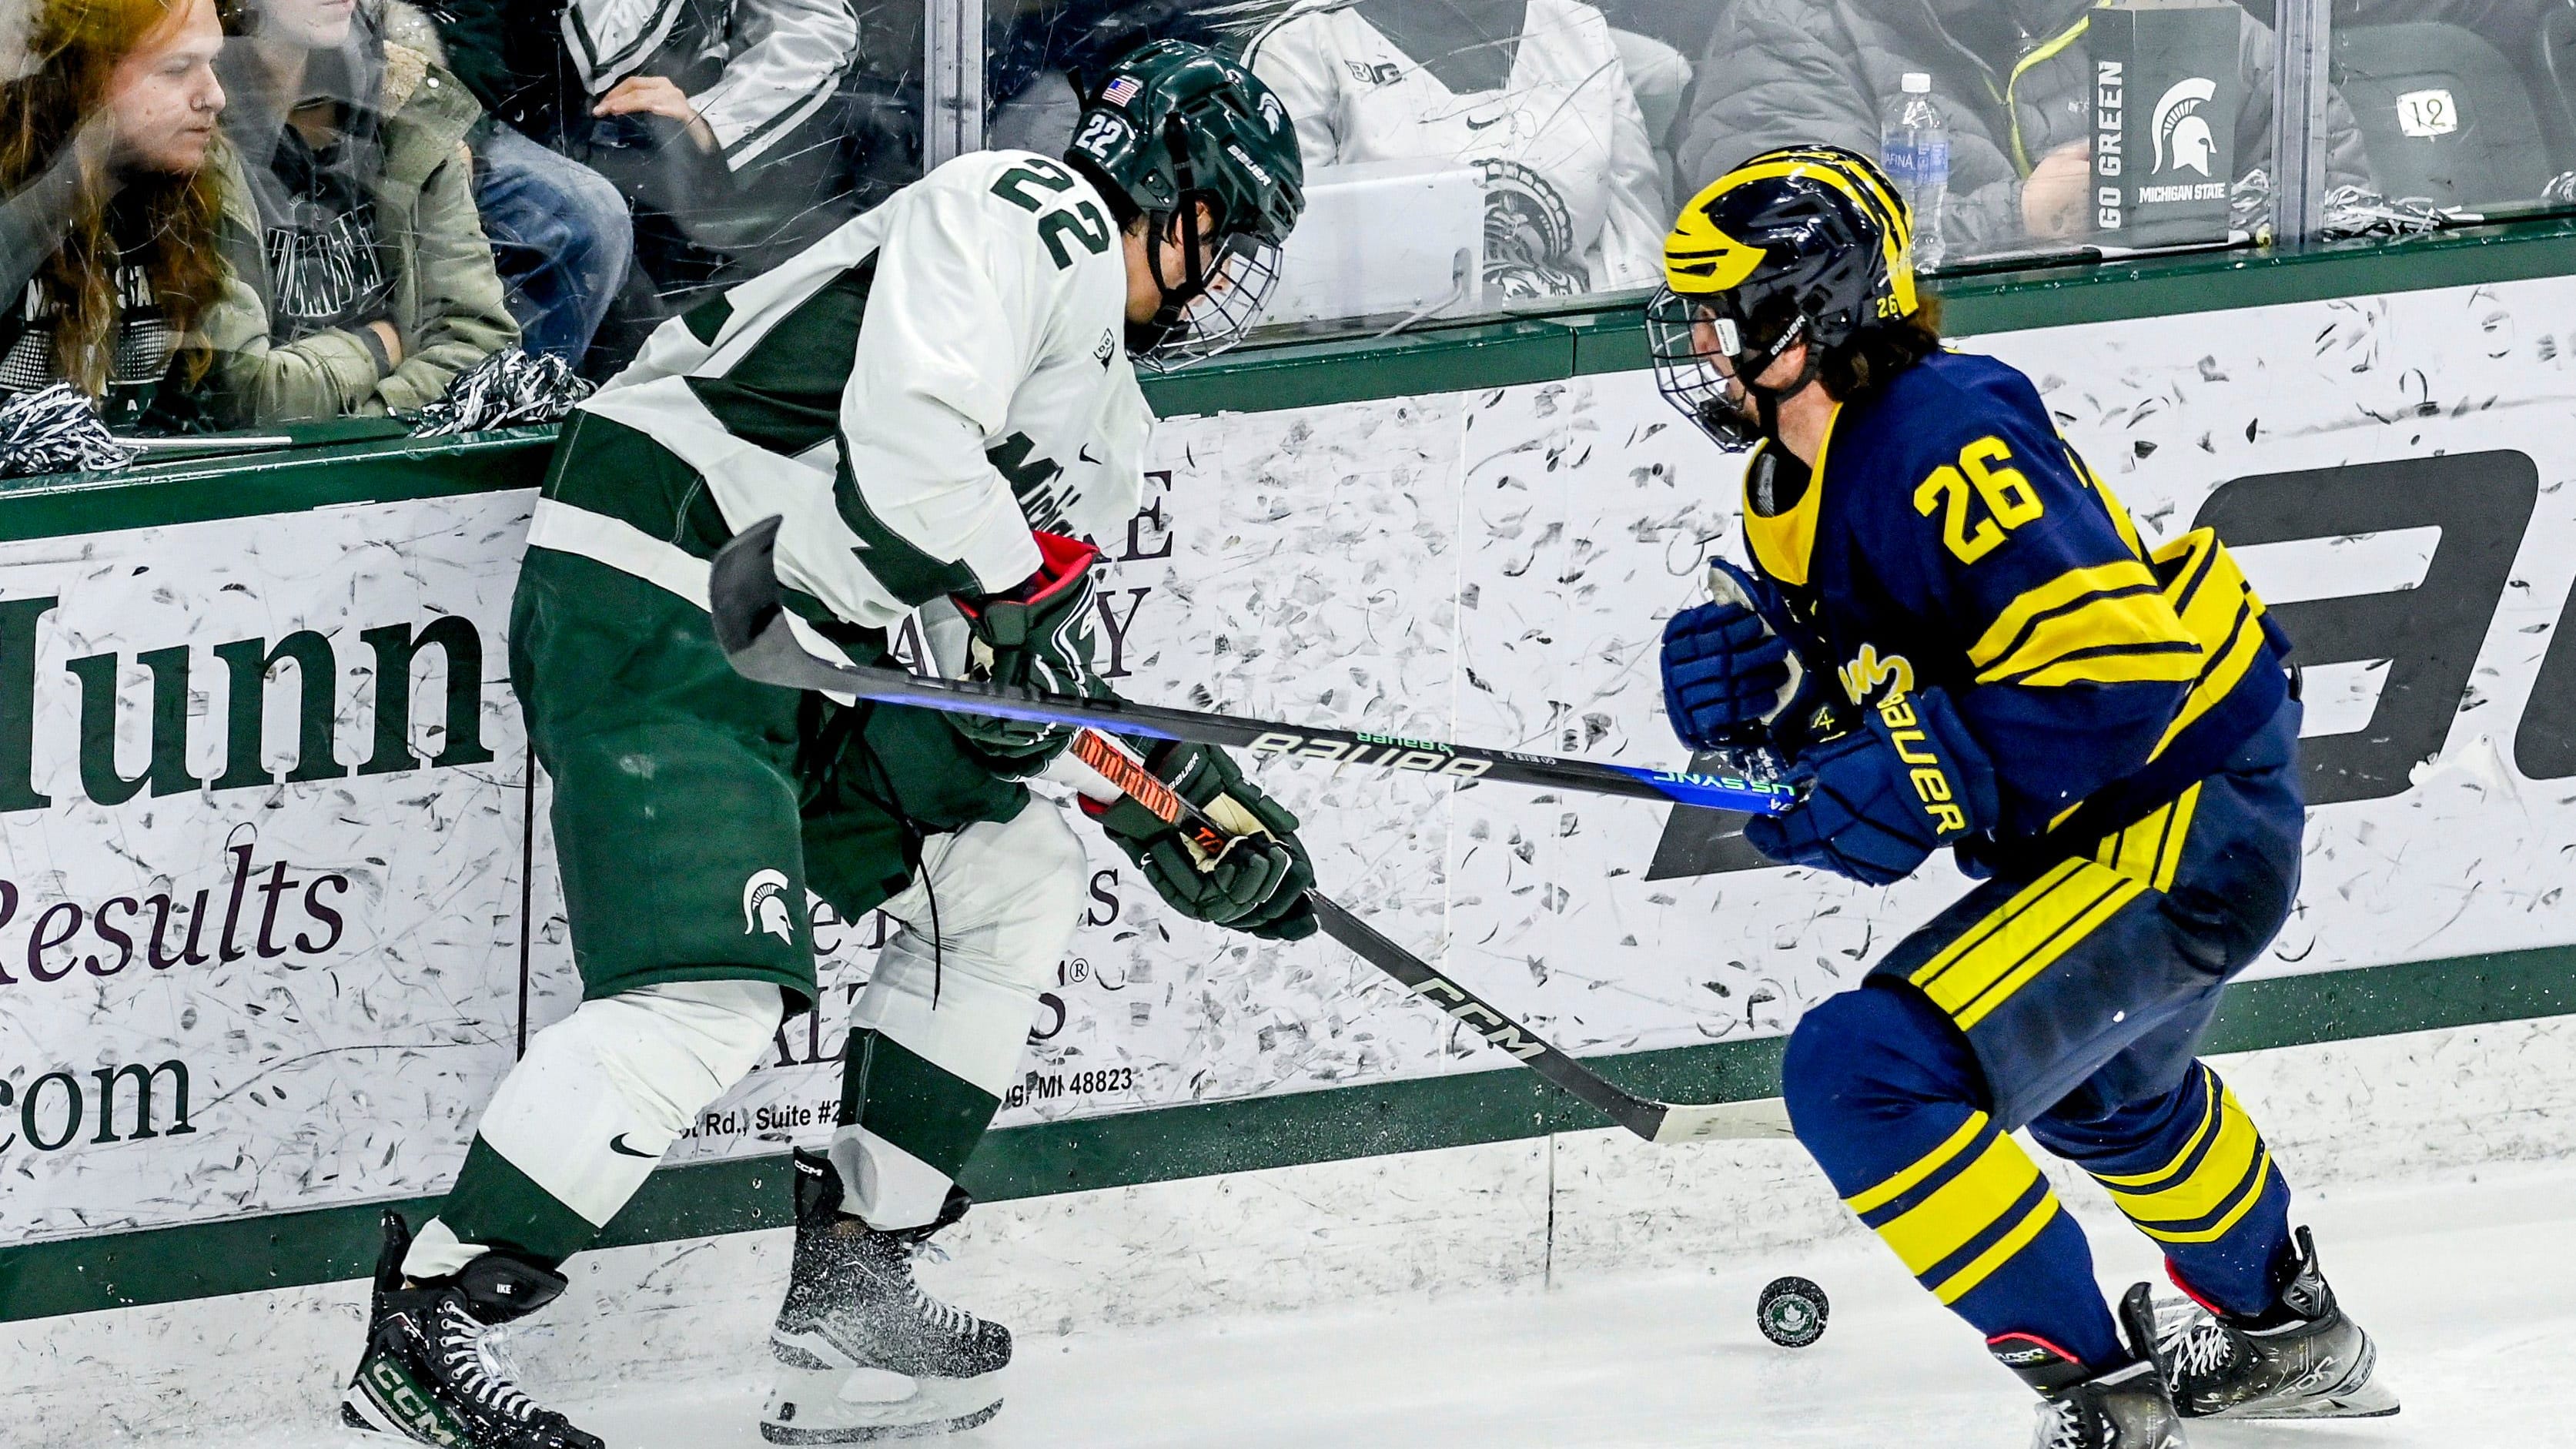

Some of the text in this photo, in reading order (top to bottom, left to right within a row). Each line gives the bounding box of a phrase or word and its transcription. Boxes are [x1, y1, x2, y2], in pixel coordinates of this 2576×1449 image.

[2410, 99, 2446, 128] 12
[1075, 113, 1123, 159] 22
[2098, 61, 2123, 229] GO GREEN
[1227, 144, 1272, 186] BAUER
[2138, 182, 2226, 204] MICHIGAN STATE
[990, 158, 1111, 271] 22
[1876, 294, 1899, 319] 26
[1770, 314, 1807, 356] BAUER
[1912, 433, 2046, 566] 26
[1357, 731, 1435, 751] BAUER
[1168, 751, 1199, 791] BAUER
[1875, 692, 1966, 836] BAUER
[1410, 977, 1547, 1060] CCM
[1039, 1074, 1062, 1099] MI
[1069, 1066, 1133, 1096] 48823
[706, 1111, 747, 1137] Rd.,
[755, 1105, 811, 1131] Suite
[794, 1160, 823, 1176] CCM
[496, 1283, 512, 1294] IKE
[373, 1360, 457, 1445] CCM
